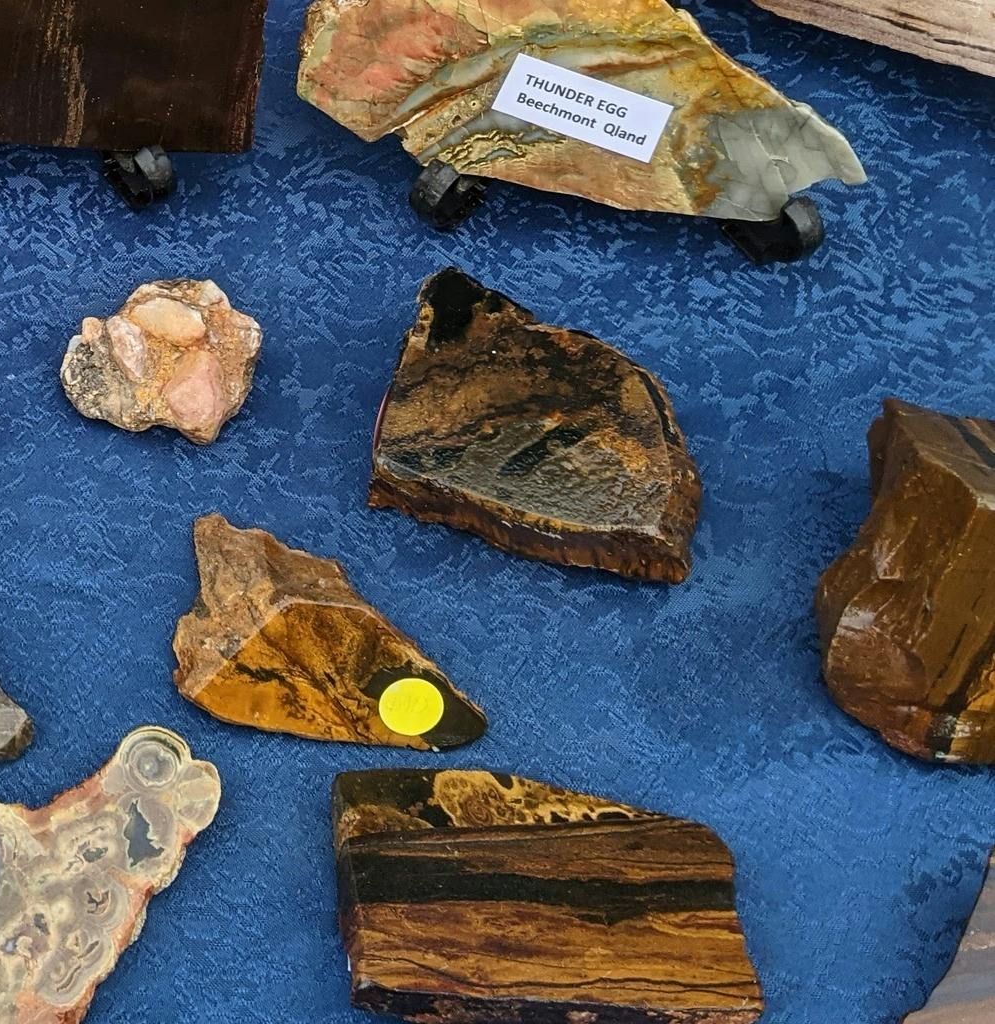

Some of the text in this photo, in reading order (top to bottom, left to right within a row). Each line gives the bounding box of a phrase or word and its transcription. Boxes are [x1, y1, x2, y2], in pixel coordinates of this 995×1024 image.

[516, 92, 647, 146] Beechmont Qland
[525, 73, 628, 119] THUNDER EGG
